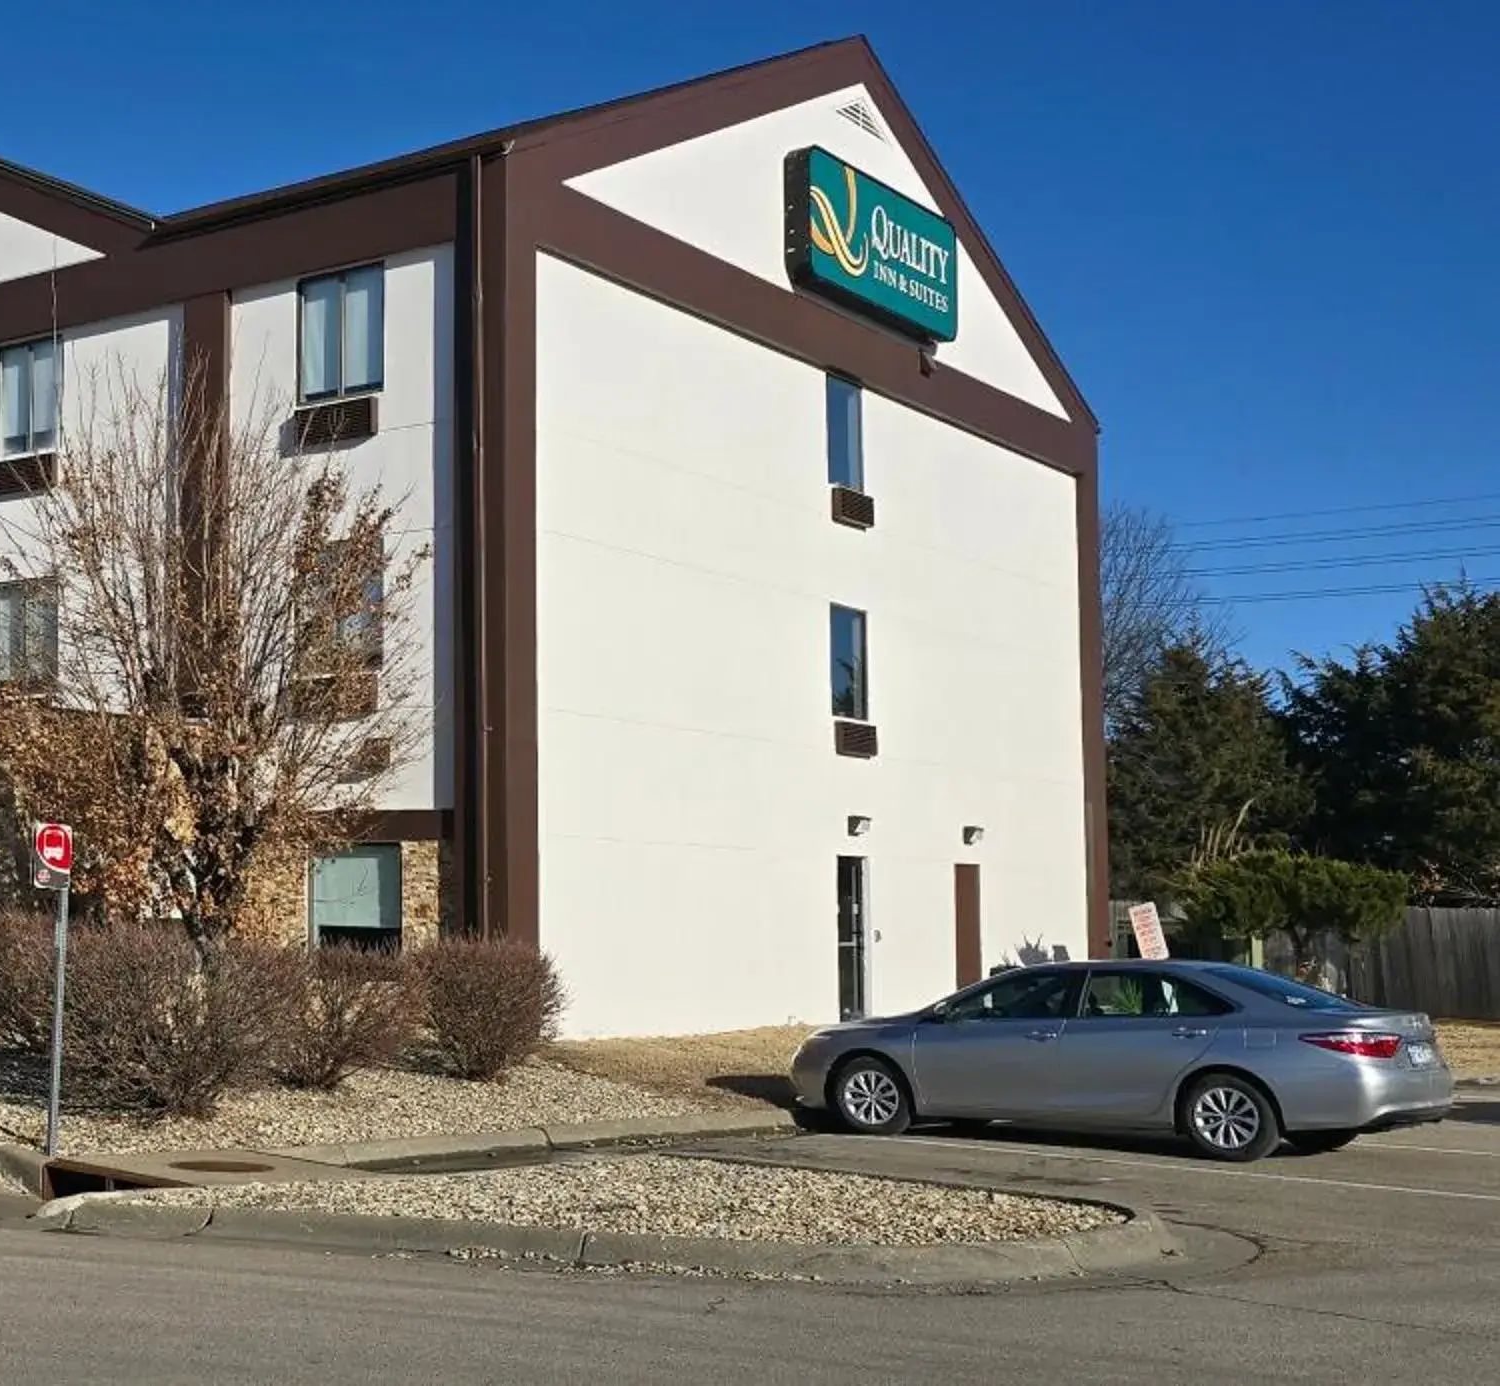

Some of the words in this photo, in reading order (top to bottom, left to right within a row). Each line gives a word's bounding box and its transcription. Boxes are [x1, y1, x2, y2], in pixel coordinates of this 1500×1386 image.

[871, 205, 949, 285] QUALITY
[873, 260, 897, 288] INN
[909, 279, 949, 312] SUITES
